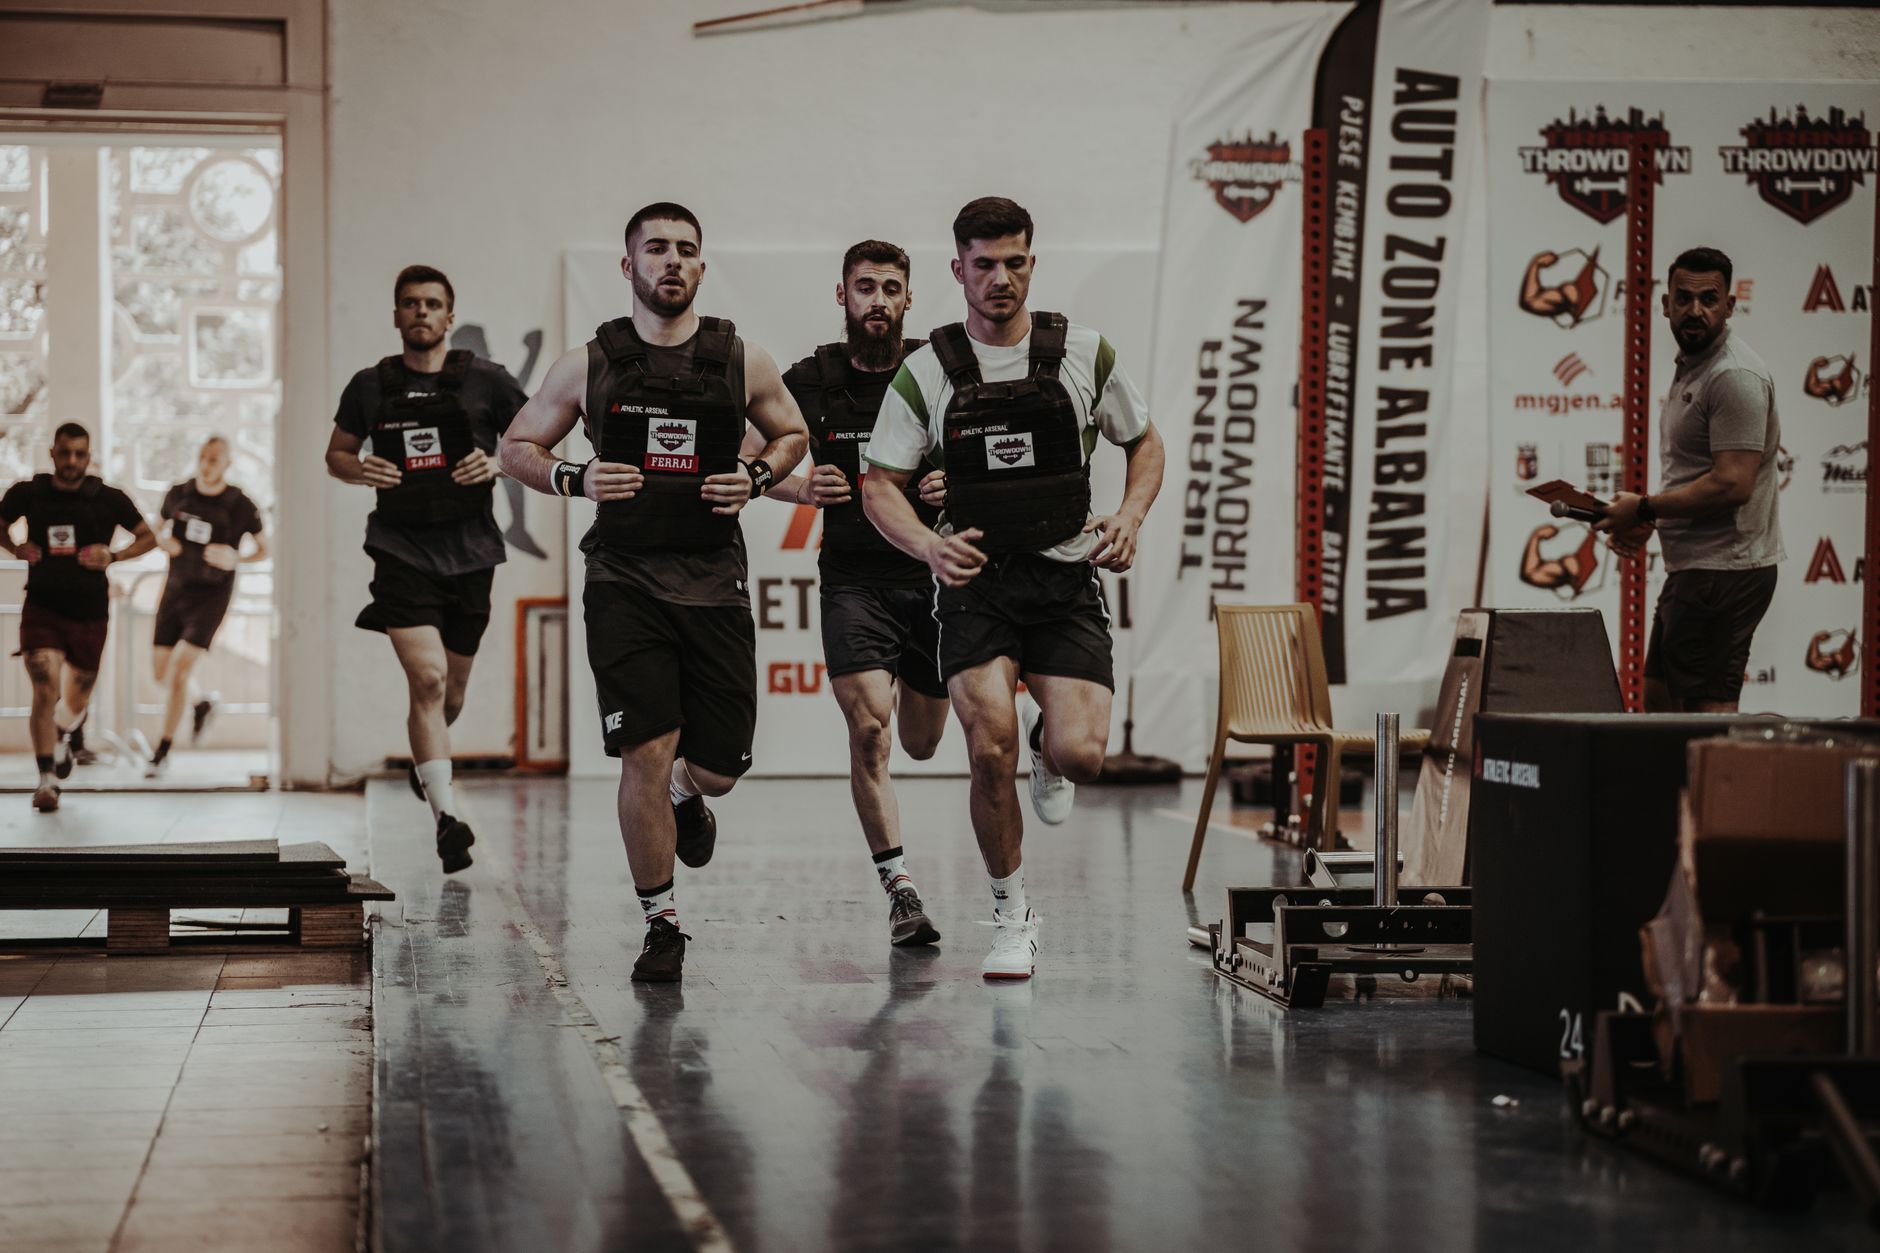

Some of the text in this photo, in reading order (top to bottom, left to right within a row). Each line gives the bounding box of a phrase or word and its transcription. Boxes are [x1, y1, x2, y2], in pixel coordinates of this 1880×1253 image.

[1338, 95, 1365, 170] PJESE
[1517, 146, 1691, 174] THROWDWN
[1718, 146, 1877, 174] THROWDOW
[1366, 67, 1460, 621] AUTO ZONE ALBANIA
[621, 404, 669, 415] ATHLETIC ARSENAL
[1322, 321, 1351, 493] LUBRIFIKANTE
[1514, 393, 1626, 414] migjen.a
[651, 431, 693, 441] THROWDOWN
[961, 424, 1008, 437] ATHLETIC ARSENAL
[651, 456, 693, 469] FERRAJ
[988, 445, 1031, 456] THROWDOWN
[1177, 340, 1222, 580] TIRANA
[1559, 1007, 1584, 1061] 24
